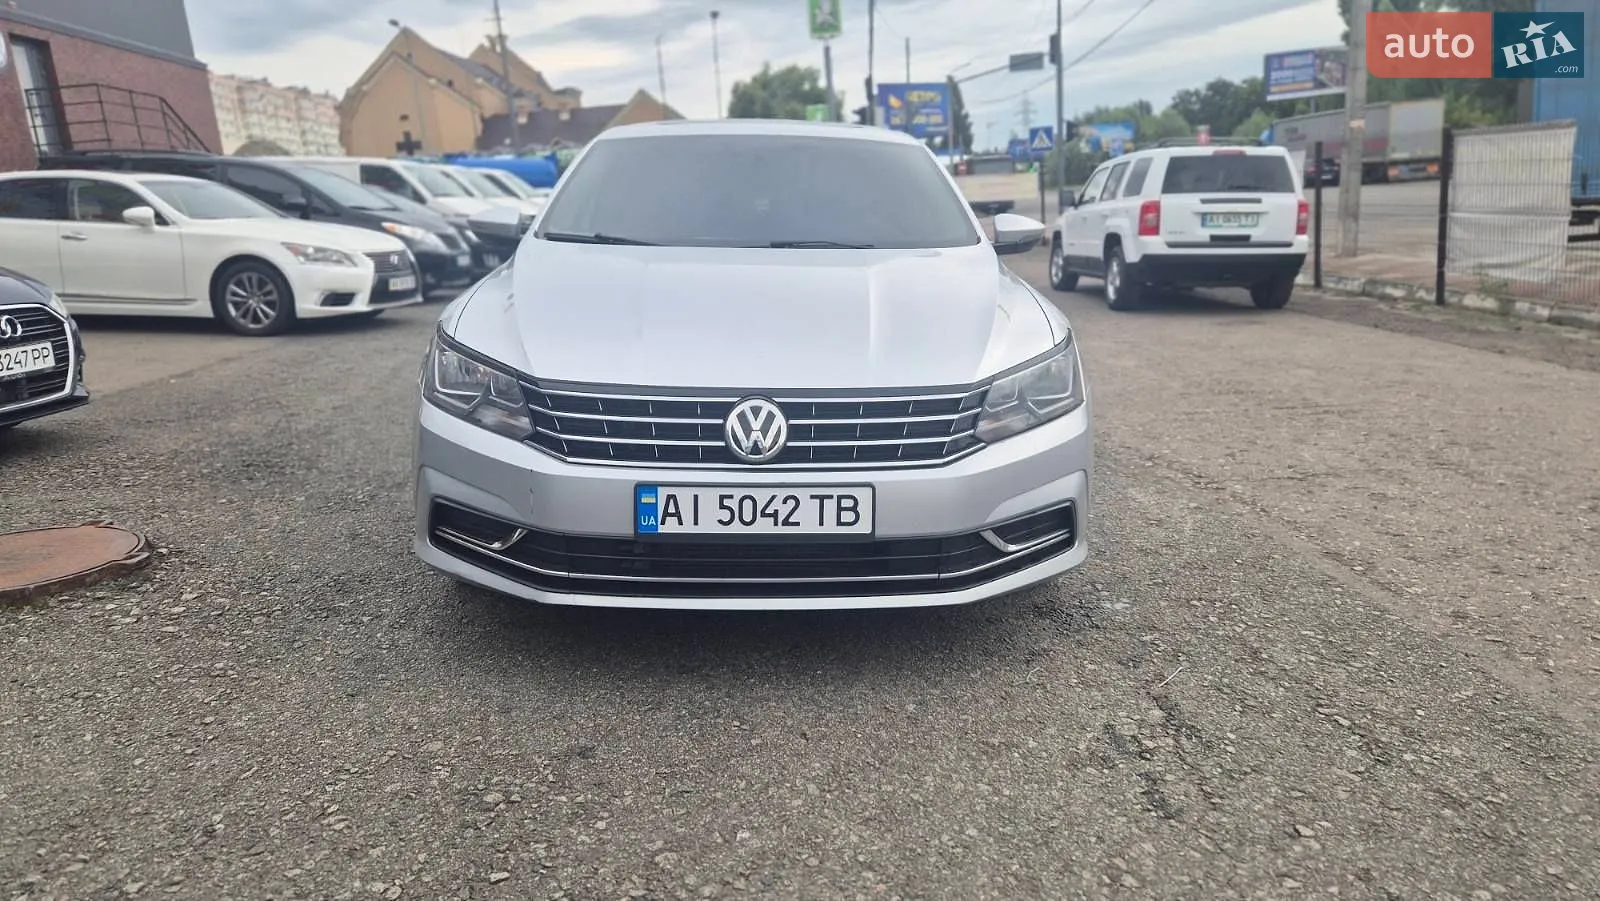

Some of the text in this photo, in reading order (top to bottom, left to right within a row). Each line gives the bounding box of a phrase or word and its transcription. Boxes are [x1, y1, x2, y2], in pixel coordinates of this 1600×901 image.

[31, 347, 50, 366] PP
[660, 494, 861, 527] AI 5042 TB
[641, 515, 656, 526] UA
